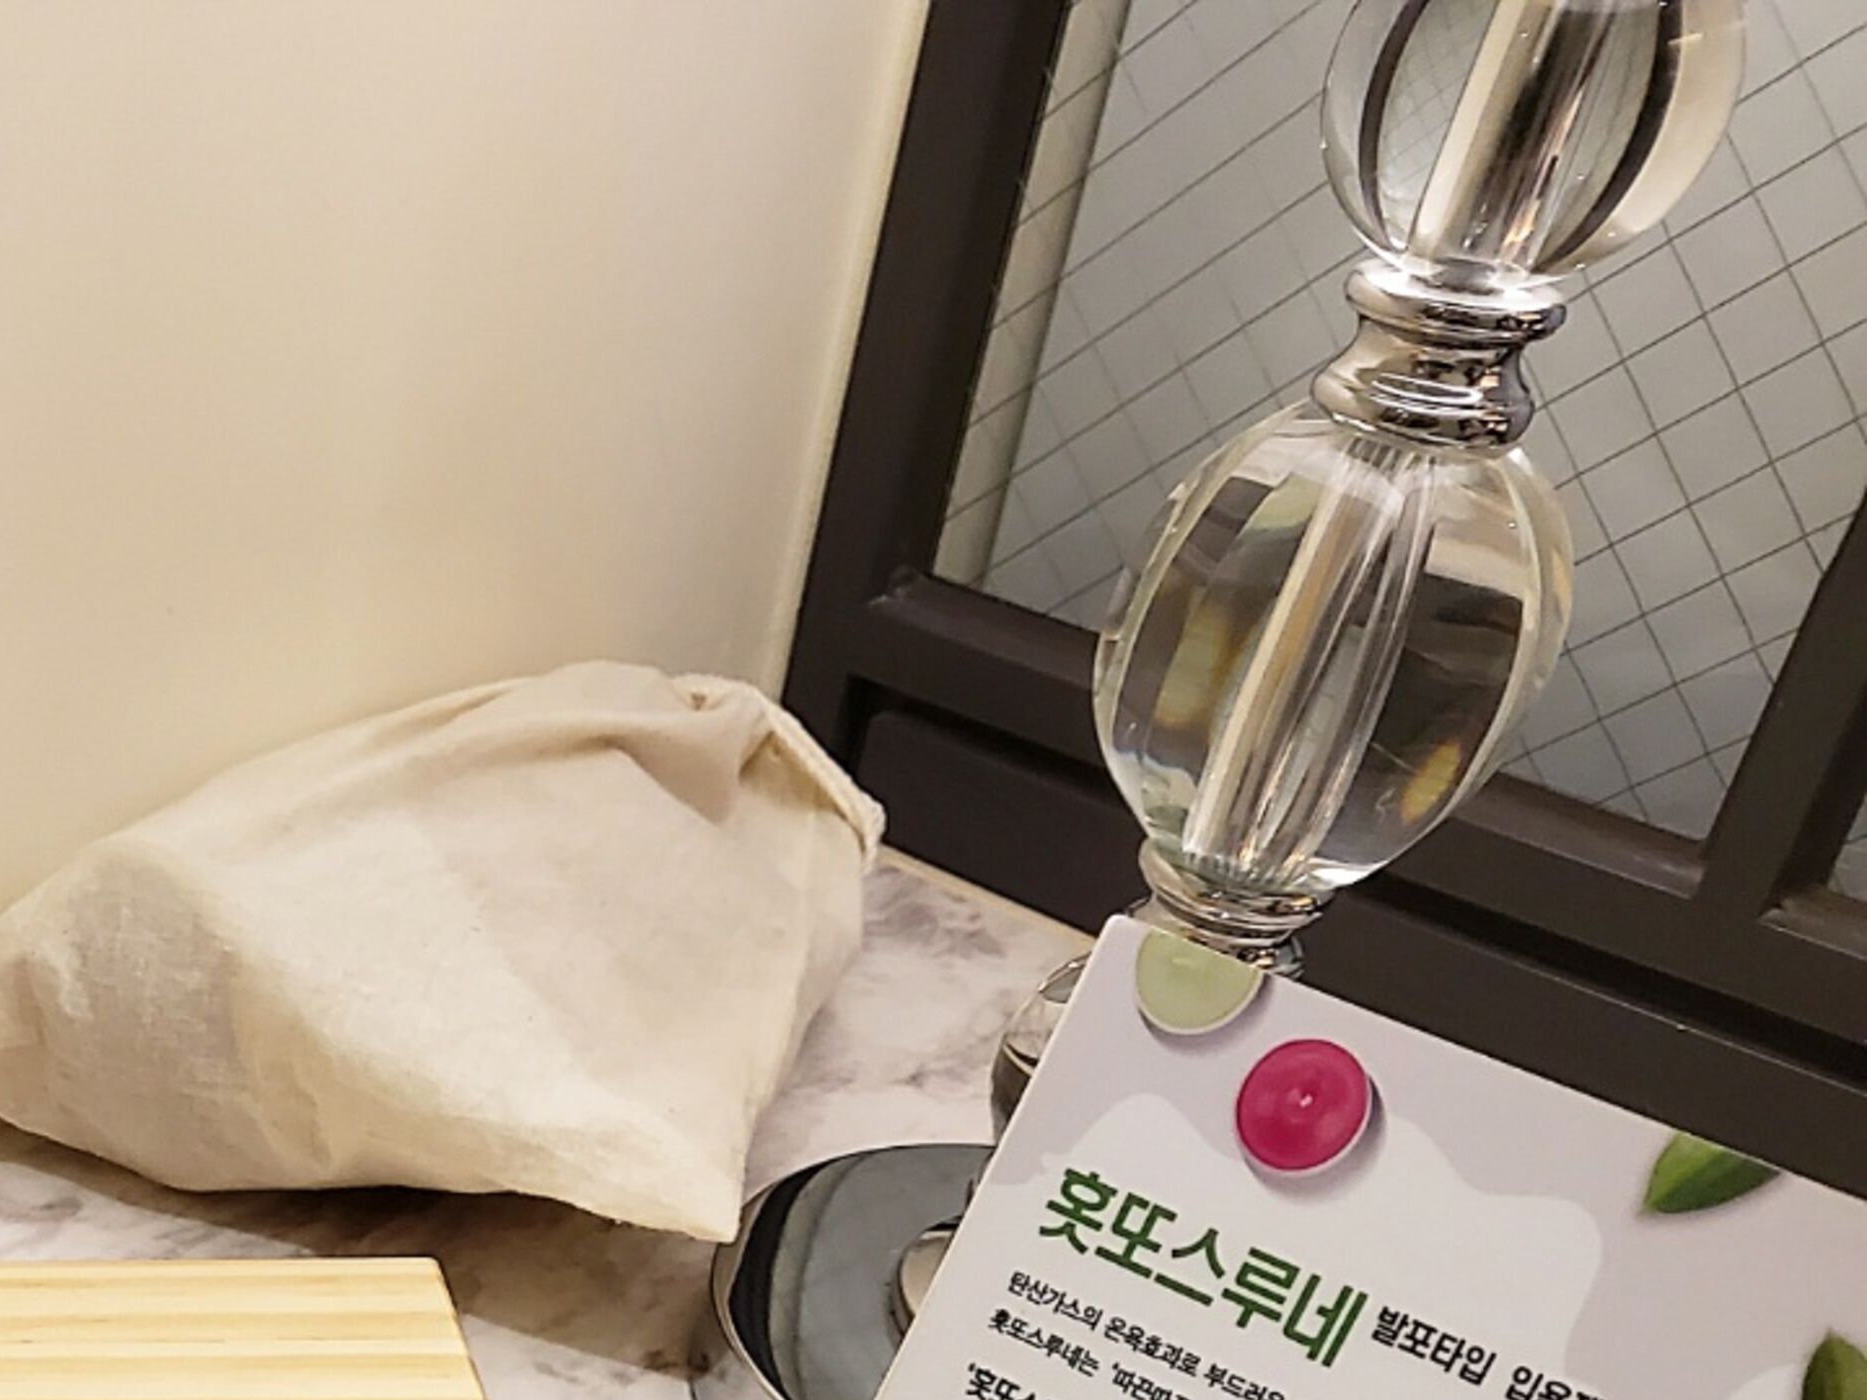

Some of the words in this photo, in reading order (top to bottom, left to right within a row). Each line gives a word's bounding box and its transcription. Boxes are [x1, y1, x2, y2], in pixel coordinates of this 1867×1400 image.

[1038, 1167, 1368, 1368] 홋또스루네
[1007, 1270, 1103, 1331] 탄산가스의
[1103, 1316, 1201, 1377] 온욕효과로
[1370, 1305, 1497, 1386] 발포타입
